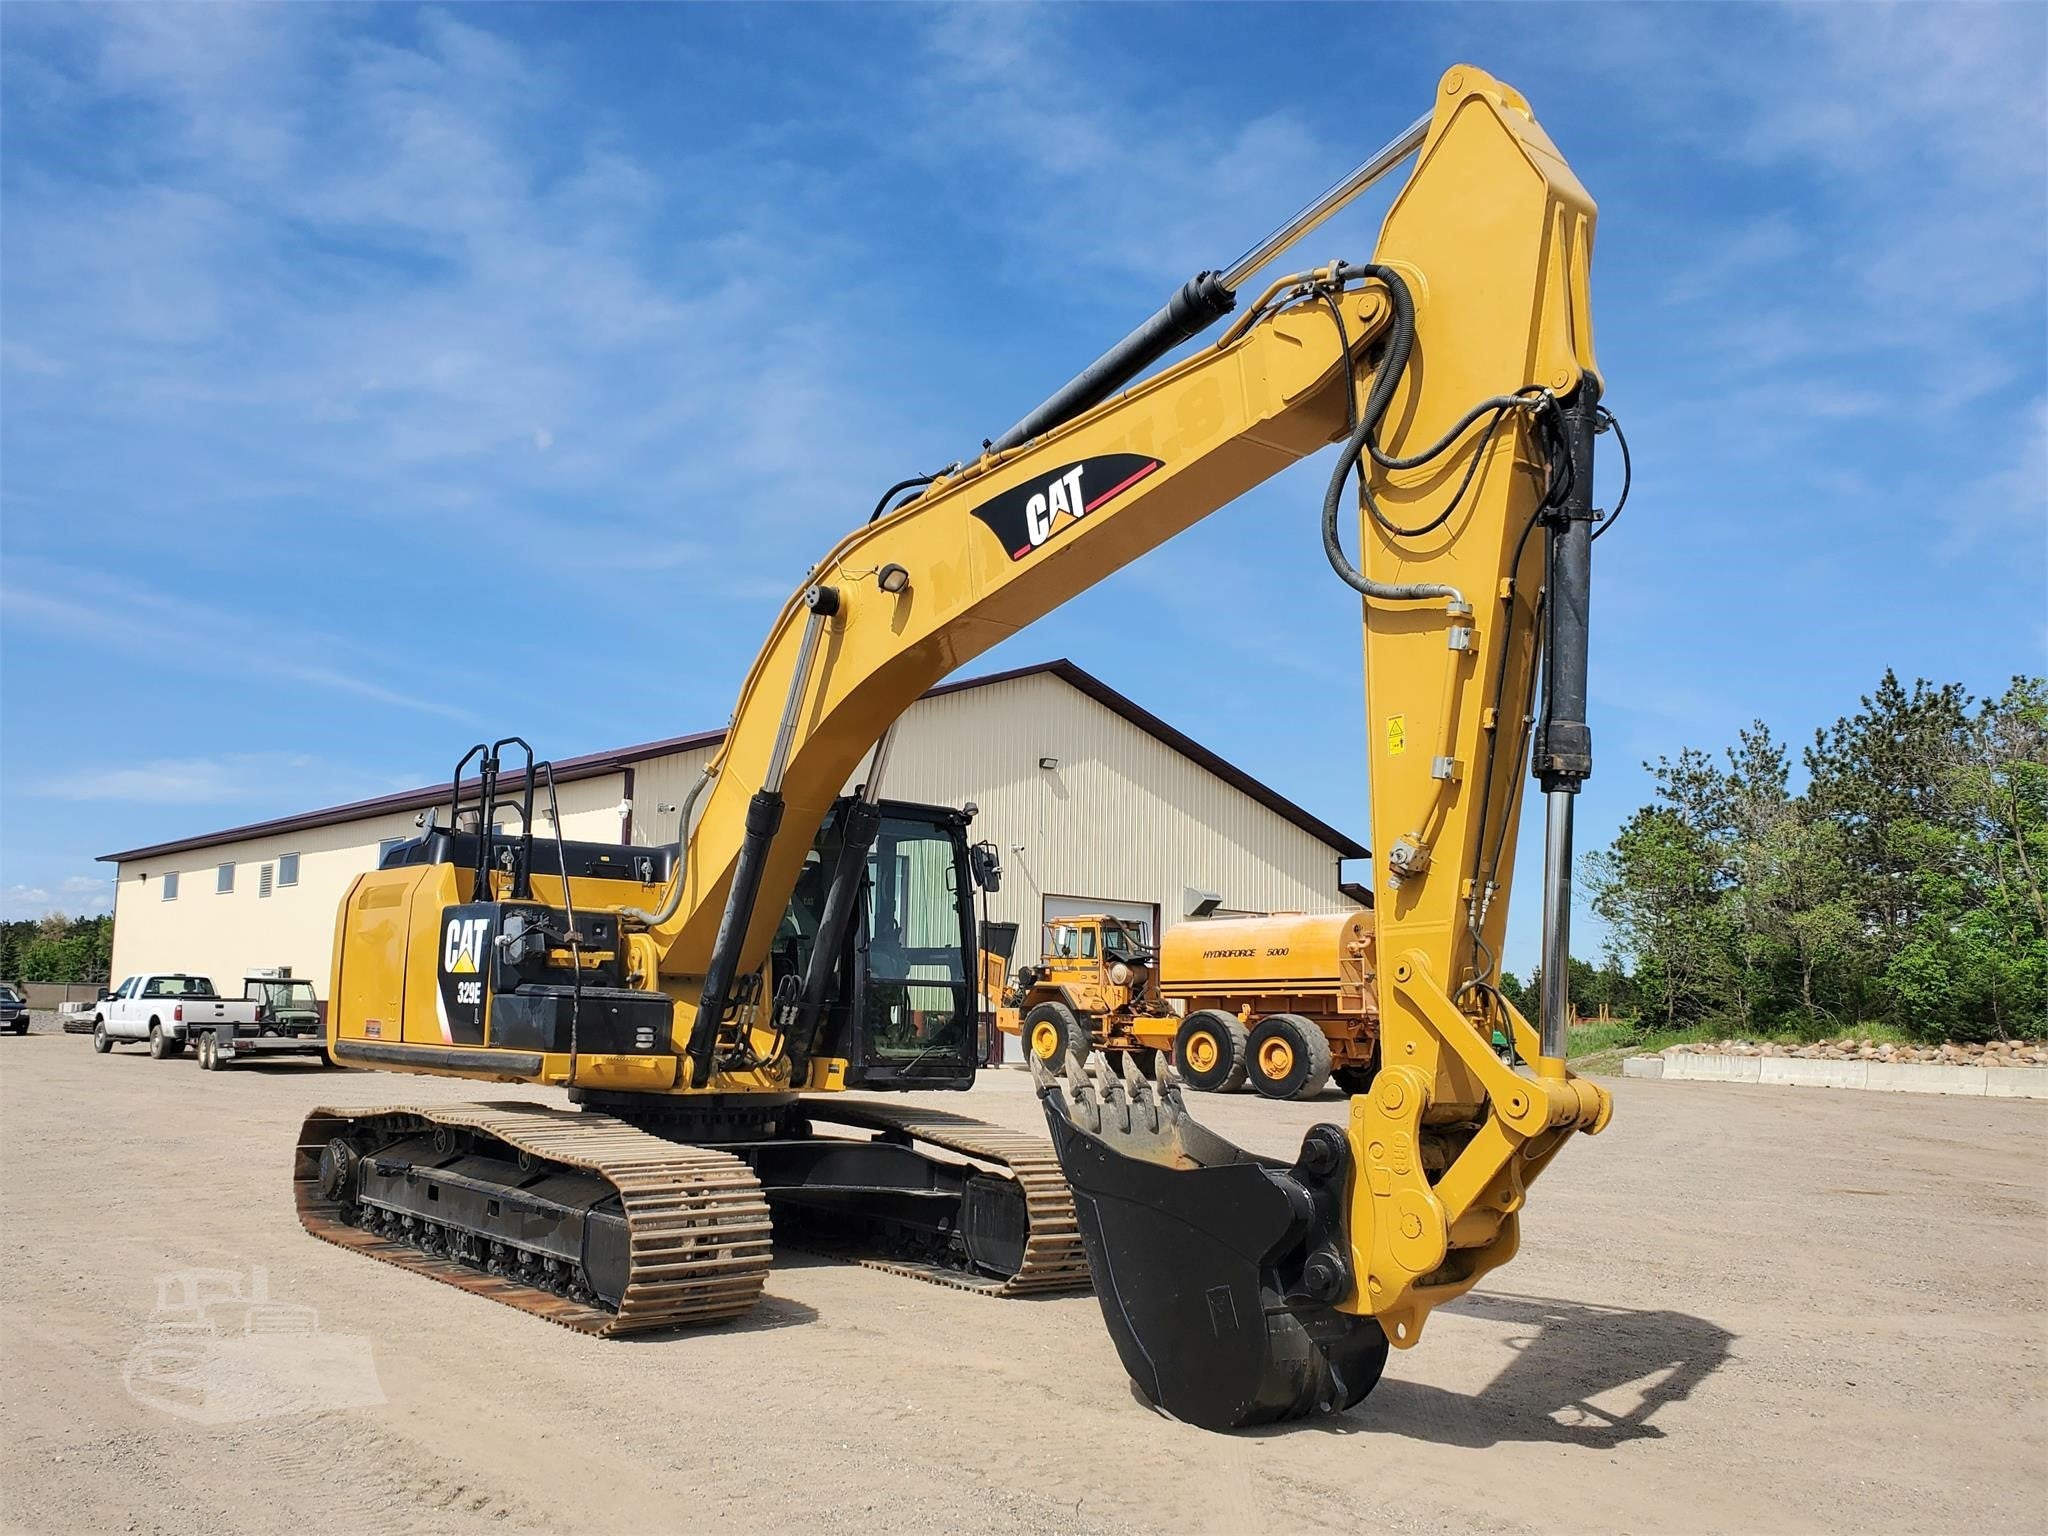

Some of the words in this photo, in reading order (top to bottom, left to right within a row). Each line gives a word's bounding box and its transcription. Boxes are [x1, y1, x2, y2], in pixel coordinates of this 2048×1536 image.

[1025, 464, 1085, 546] CAT
[444, 918, 489, 974] CAT
[1202, 948, 1257, 959] HYDROFORCE
[1266, 947, 1290, 957] 5000
[457, 981, 482, 1004] 329E
